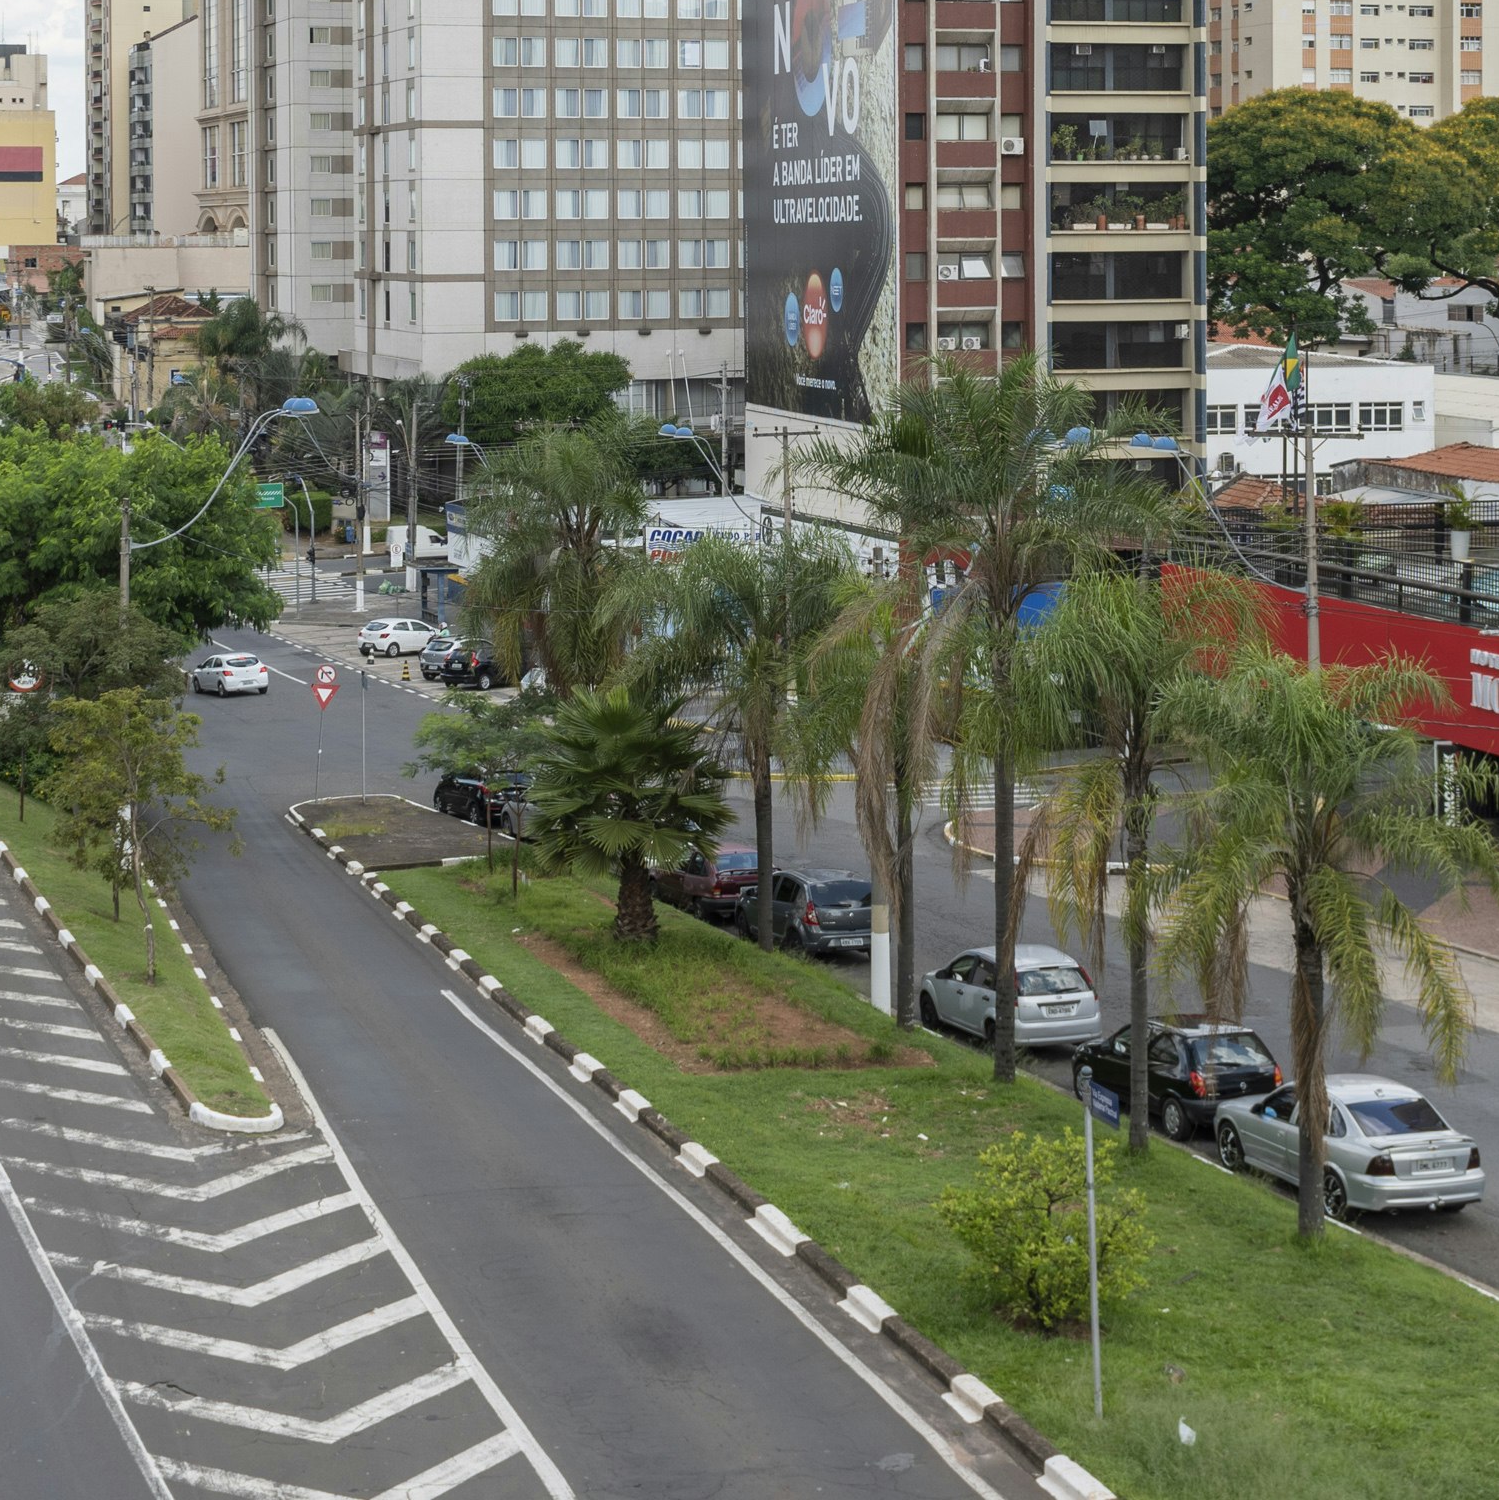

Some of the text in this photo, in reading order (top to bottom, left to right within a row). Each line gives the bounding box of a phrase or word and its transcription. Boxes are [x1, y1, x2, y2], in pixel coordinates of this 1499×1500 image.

[772, 117, 799, 149] É TER
[773, 150, 861, 187] A BANDA LÍDER EM
[773, 194, 863, 224] ULTRAVELOCIDADE.
[804, 301, 824, 325] Claro
